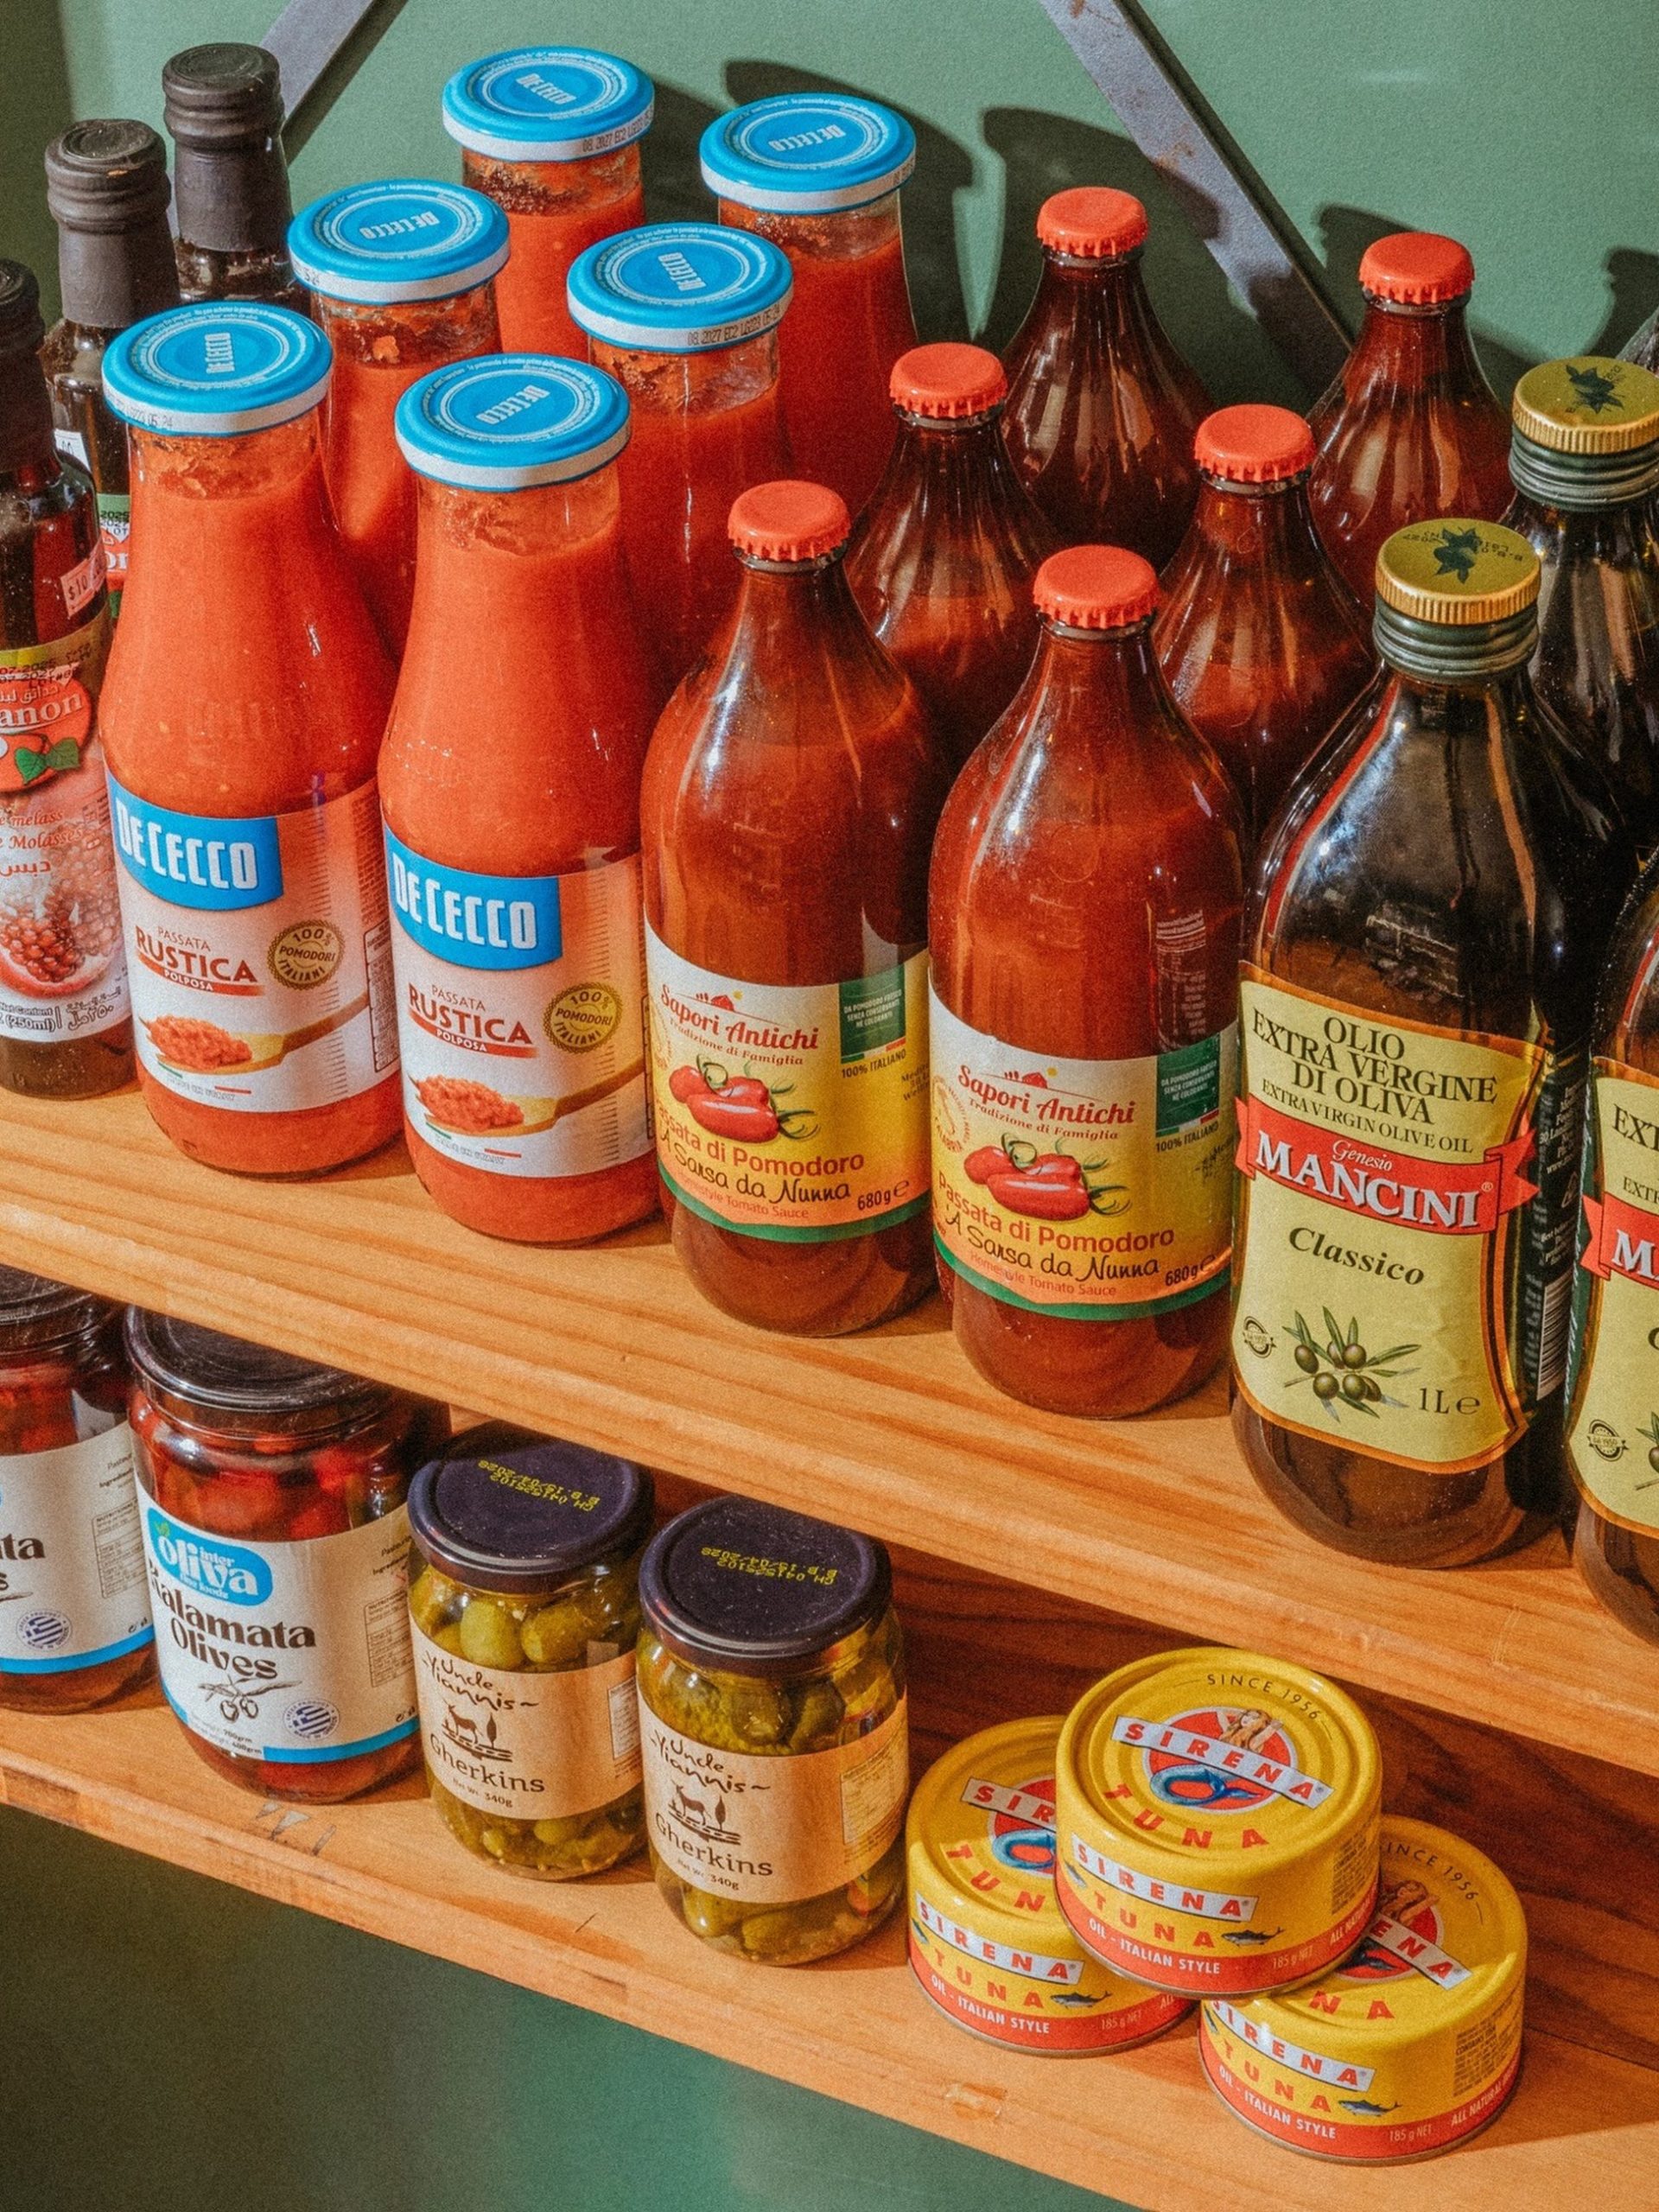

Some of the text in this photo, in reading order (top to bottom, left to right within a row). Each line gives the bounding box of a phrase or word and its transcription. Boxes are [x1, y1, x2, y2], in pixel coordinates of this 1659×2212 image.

[701, 328, 721, 345] 2027
[0, 692, 83, 727] anon
[9, 827, 83, 849] Molasses
[135, 925, 257, 983] RUSTICA
[157, 925, 212, 952] PASSATA
[279, 944, 335, 963] POMODORI
[293, 928, 335, 948] 100%
[162, 969, 214, 992] POLPOSA
[277, 958, 327, 982] ITALIANI
[408, 982, 533, 1045] RUSTICA
[432, 984, 486, 1012] PASSATA
[555, 1007, 613, 1027] POMODORI
[570, 990, 613, 1009] 100%
[660, 983, 819, 1050] Sapori Antichi
[435, 1029, 488, 1052] POLPOSA
[554, 1021, 601, 1046] ITALIANI
[669, 1017, 804, 1066] Tradizione di Famiglia
[1253, 1007, 1498, 1104] EXTRA VERGINE
[1324, 1016, 1405, 1060] OLIO
[842, 1048, 907, 1079] 100% ITALIANO
[957, 1064, 1030, 1114] Sapori
[1036, 1097, 1136, 1125] Antichi
[1261, 1078, 1473, 1154] EXTRA VIRGIN OLIVE OIL
[1291, 1060, 1433, 1124] DI OLIVA
[968, 1097, 1119, 1141] Tradizione di Famiglia
[1155, 1122, 1220, 1153] 100% ITALIANO
[674, 1141, 850, 1205] Sarsa da Nunna
[707, 1140, 727, 1163] di
[733, 1147, 865, 1176] Pomodoro
[1255, 1129, 1480, 1229] MANCINI
[1332, 1139, 1394, 1173] Genesio
[725, 1193, 769, 1216] Tomato
[772, 1206, 810, 1218] Sauce
[857, 1190, 892, 1211] 680g
[938, 1170, 1175, 1253] Passata di Pomodoro
[967, 1224, 1160, 1283] Sarsa da Nunna
[969, 1252, 1117, 1296] Homestyle Tomato Sauce
[1165, 1264, 1199, 1287] 680g
[1288, 1226, 1425, 1287] Classico
[1419, 1387, 1452, 1415] 1L
[157, 1535, 258, 1596] oliva
[199, 1545, 235, 1567] inter
[170, 1618, 277, 1680] Olives
[423, 1649, 515, 1711] Yiannis
[442, 1659, 493, 1690] Uncle
[1206, 1673, 1321, 1721] SINCE 1956
[429, 1733, 545, 1793] Gherkins
[651, 1729, 746, 1793] Yiannis
[670, 1738, 724, 1772] Uncle
[1123, 1722, 1315, 1801] SIRENA
[484, 1791, 513, 1808] 340g
[974, 1785, 1055, 1823] SIR
[1103, 1782, 1270, 1850] TUNA
[655, 1812, 774, 1877] Gherkins
[709, 1873, 740, 1891] 340g
[945, 1843, 1046, 1911] TUN
[1077, 1842, 1243, 1917] SIRENA
[1387, 1841, 1478, 1900] INCE 1956
[919, 1901, 1069, 1980] SIRENA
[1093, 1890, 1216, 1949] TUNA
[1088, 1917, 1221, 1975] OIL ITALIAN STYLE
[1371, 1921, 1453, 1980] ENA
[934, 1947, 1044, 2009] TUNA
[931, 1974, 1050, 2035] OIL ITALIAN STYLE
[1308, 1990, 1395, 2020] NA
[1212, 1999, 1358, 2087] SIRENA
[1223, 2037, 1332, 2113] TUNA
[1218, 2064, 1336, 2139] OIL ITALIAN STYLE
[1450, 2111, 1467, 2127] ALL
[1389, 2128, 1407, 2144] 185
[1416, 2123, 1433, 2138] NET
